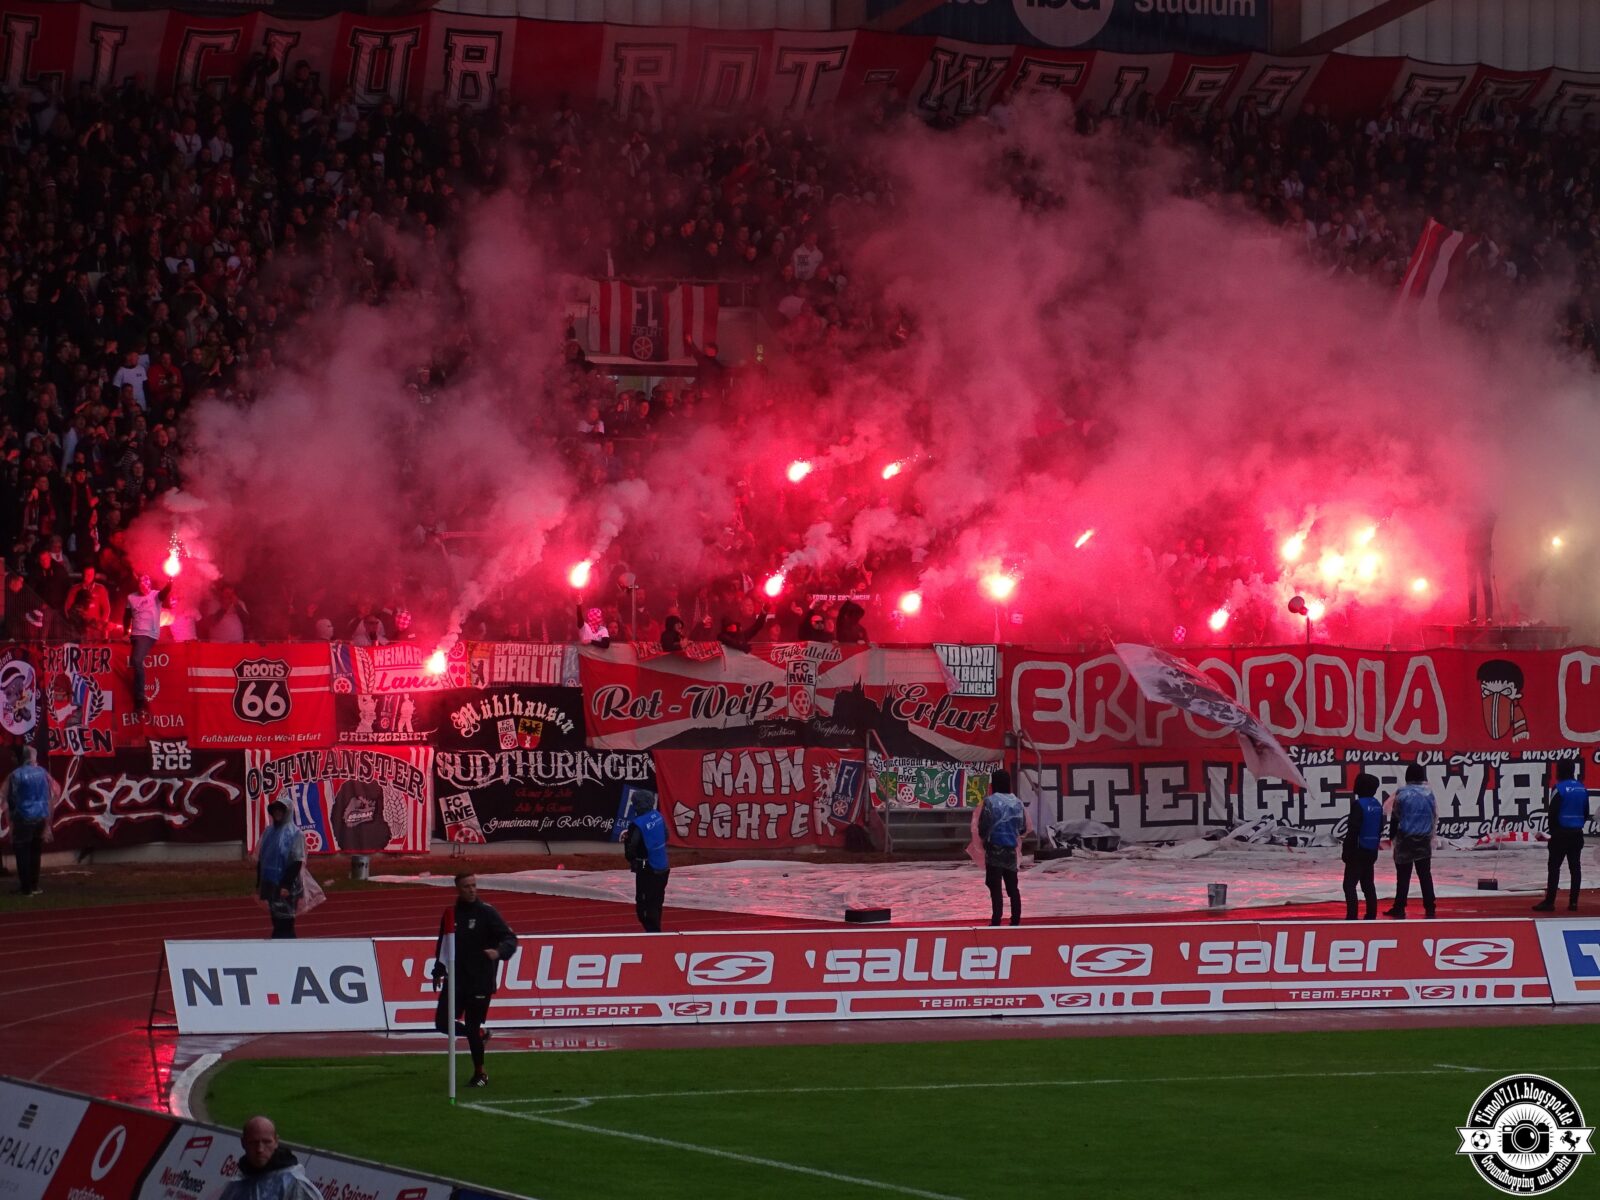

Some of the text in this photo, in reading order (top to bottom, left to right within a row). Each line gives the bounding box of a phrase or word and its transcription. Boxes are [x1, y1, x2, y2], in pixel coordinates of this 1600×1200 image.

[494, 643, 563, 656] SPORTGRUPPE
[126, 653, 169, 668] LGIO
[493, 655, 562, 684] BERLIN
[793, 662, 809, 673] FC
[243, 663, 285, 677] ROOTS
[789, 673, 814, 683] RWE
[241, 681, 286, 717] 66
[450, 692, 575, 737] Mühlhausen
[891, 684, 999, 733] Erfurt
[48, 728, 114, 754] BUBEN
[297, 732, 321, 741] Erfurt
[338, 731, 429, 742] GRENZGEBIET
[149, 740, 192, 754] FCK
[1287, 746, 1335, 766] Einst
[151, 754, 191, 771] FCC
[903, 767, 914, 775] FC
[246, 750, 426, 804] OSTWANSTER
[701, 747, 807, 797] MAIN
[898, 775, 917, 783] RWE
[446, 796, 463, 809] FC
[444, 805, 474, 823] RWE
[673, 800, 838, 841] FIGHTER
[482, 815, 614, 834] Gemeinsam für Rot-Weiß
[181, 965, 369, 1007] NT.AG
[0, 1136, 60, 1176] PALAIS
